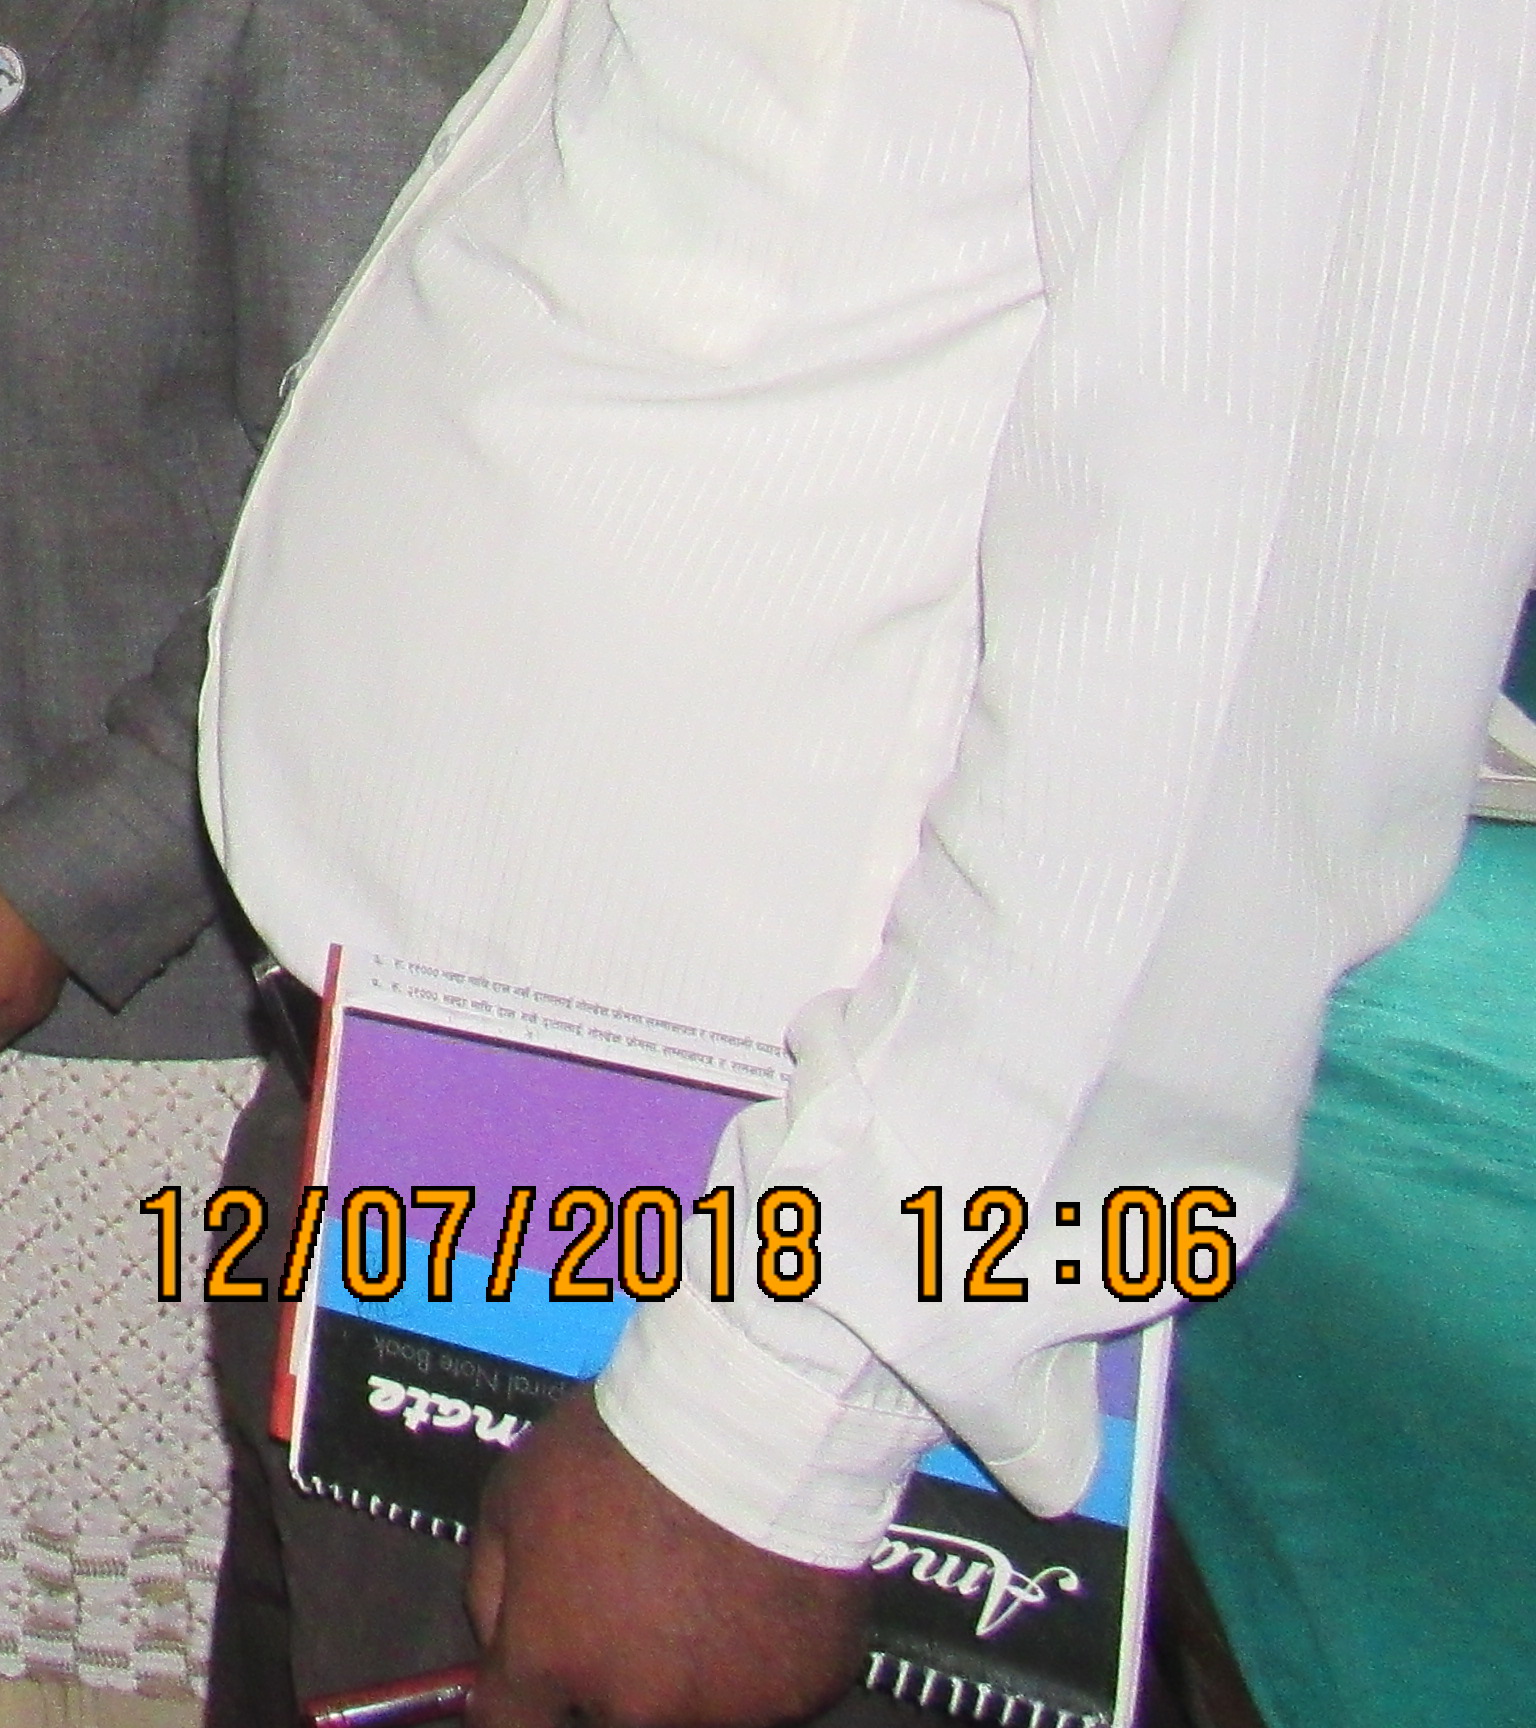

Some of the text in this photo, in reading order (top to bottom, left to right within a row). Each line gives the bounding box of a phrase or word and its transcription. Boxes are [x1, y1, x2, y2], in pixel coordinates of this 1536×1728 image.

[372, 1337, 566, 1403] piral Note Book
